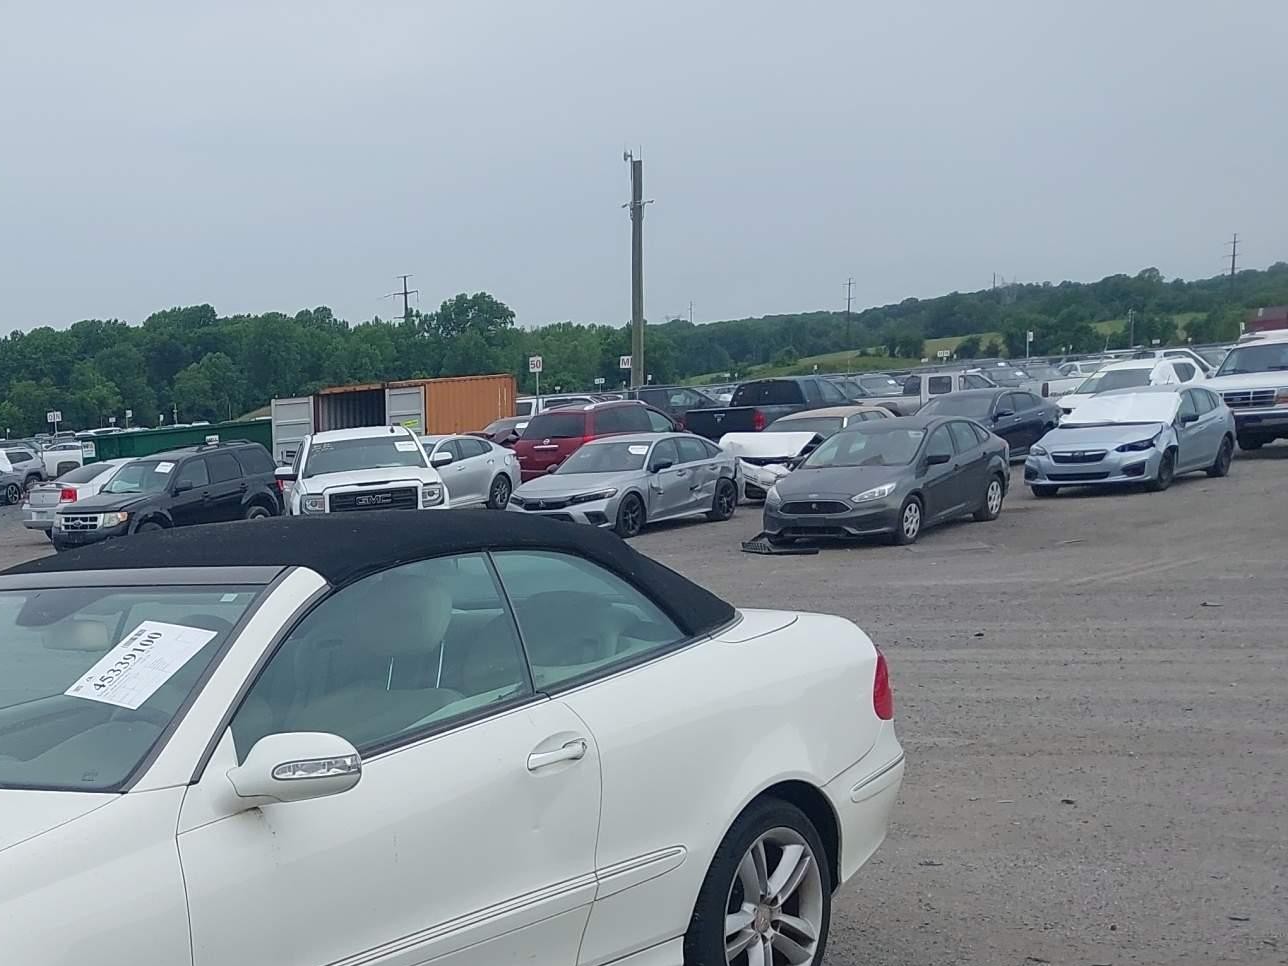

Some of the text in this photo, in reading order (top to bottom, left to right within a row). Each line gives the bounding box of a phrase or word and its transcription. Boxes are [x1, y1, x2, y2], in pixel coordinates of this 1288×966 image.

[530, 360, 541, 369] 50
[356, 494, 392, 505] GMC
[93, 632, 163, 691] 45339100
